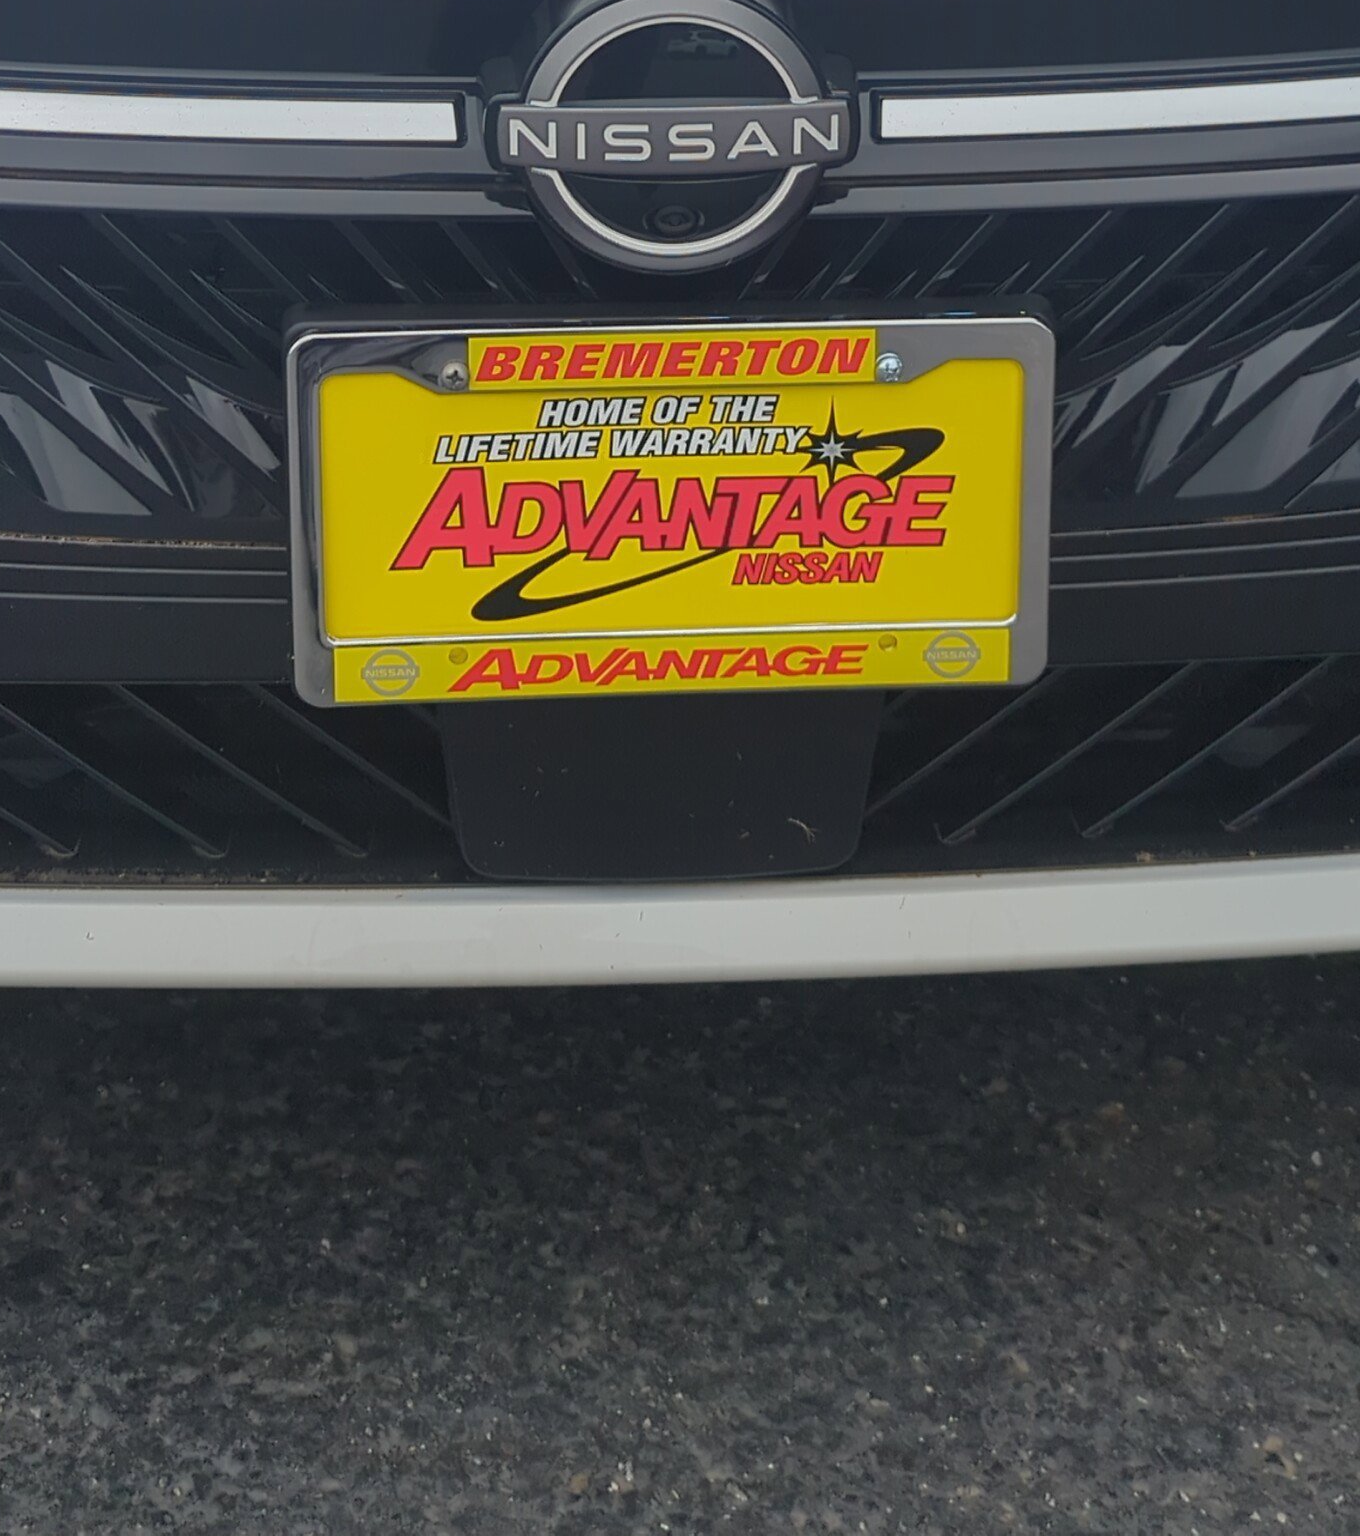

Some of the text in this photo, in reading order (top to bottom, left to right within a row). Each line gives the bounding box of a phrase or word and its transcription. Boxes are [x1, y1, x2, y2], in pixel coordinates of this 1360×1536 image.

[508, 114, 840, 162] NISSAN
[474, 335, 872, 383] BREMERTON
[537, 394, 778, 428] HOME OF THE
[433, 425, 810, 465] LIFETIME WARRANTY
[389, 467, 957, 573] ADVANTAGE
[731, 551, 884, 586] NISSAN
[364, 667, 416, 678] NISSAN
[448, 644, 870, 693] ADVANTAGE
[926, 650, 977, 660] NISSAN
